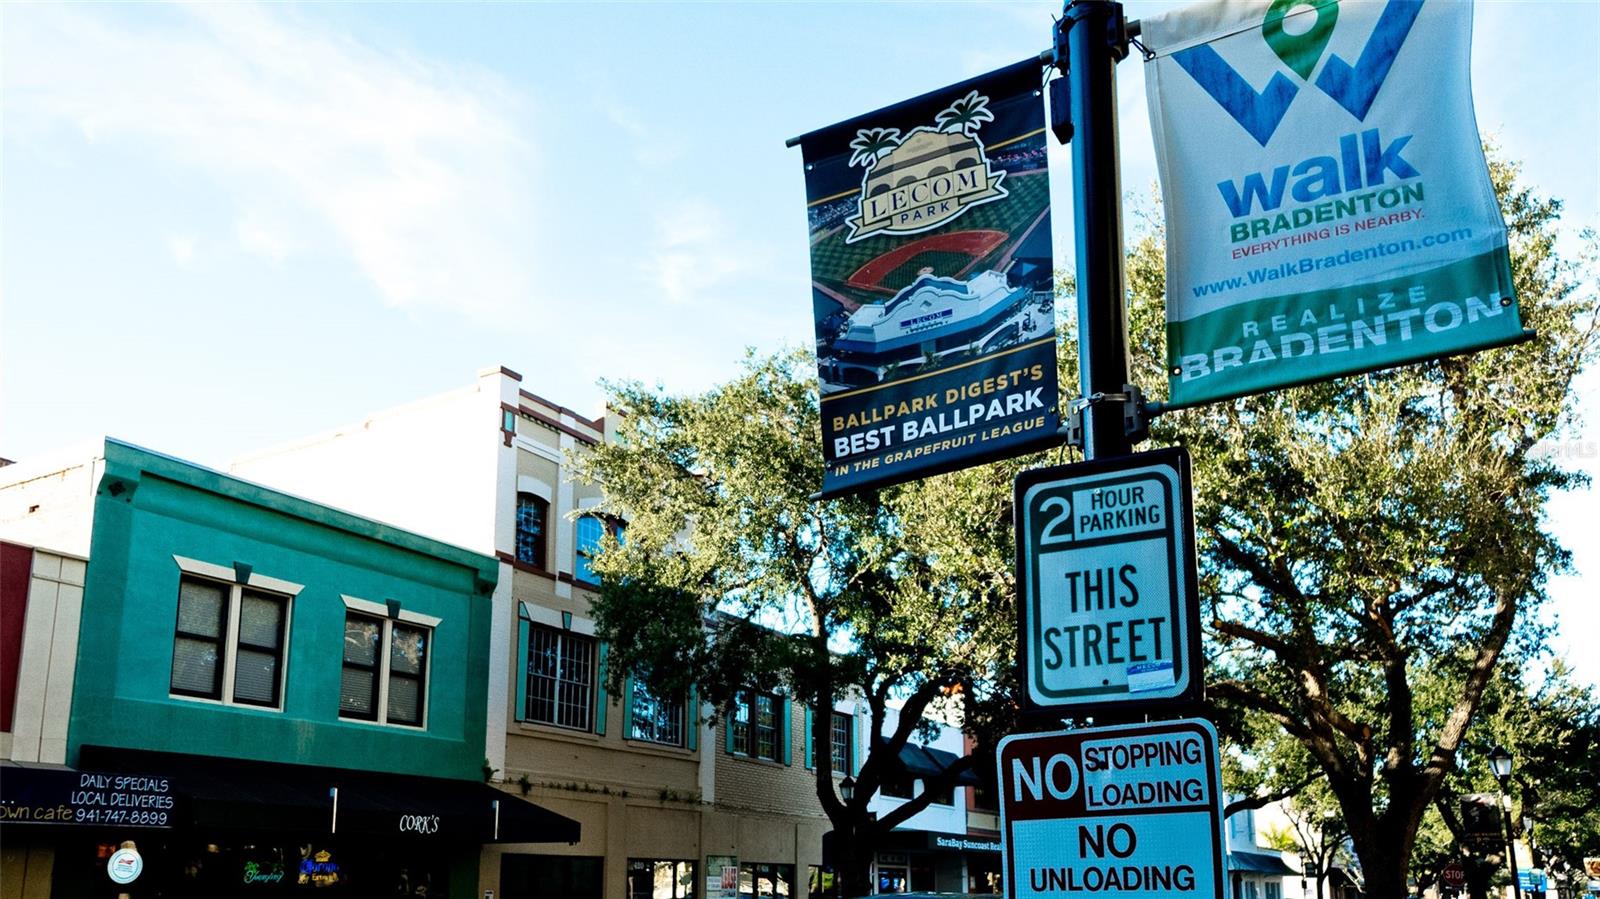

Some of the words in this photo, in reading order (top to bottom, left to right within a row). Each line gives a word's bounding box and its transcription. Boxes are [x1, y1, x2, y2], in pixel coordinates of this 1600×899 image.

[870, 168, 980, 219] LECOM
[1217, 128, 1420, 218] walk
[900, 201, 950, 224] PARK
[1230, 182, 1425, 243] BRADENTON
[1232, 227, 1331, 260] EVERYTHING
[1335, 222, 1350, 238] IS
[1354, 208, 1425, 231] NEARBY.
[1193, 226, 1472, 298] www.WalkBradenton.com
[1243, 286, 1427, 338] REALIZE
[1181, 292, 1503, 383] BRADENTON
[833, 394, 938, 432] BALLPARK
[946, 364, 1043, 404] DIGEST'S
[834, 425, 896, 458] BEST
[903, 387, 1044, 442] BALLPARK
[835, 465, 849, 477] IN
[854, 458, 879, 473] THE
[885, 434, 976, 464] GRAPEFRUIT
[982, 416, 1045, 441] LEAGUE
[1039, 496, 1073, 546] 2
[1080, 504, 1160, 533] PARKING
[1092, 486, 1144, 510] HOUR
[1065, 564, 1139, 613] THIS
[1043, 616, 1165, 670] STREET
[1012, 753, 1080, 802] NO
[1084, 738, 1201, 772] STOPPING
[71, 791, 107, 805] LOCAL
[110, 792, 174, 809] DELIVERIES
[80, 774, 113, 788] DAILY
[114, 776, 169, 792] SPECIALS
[1088, 778, 1203, 807] LOADING
[33, 804, 73, 820] cafe
[75, 808, 167, 825] 941-747-8899
[936, 837, 962, 850] SaraBay
[1078, 823, 1137, 858] NO
[1030, 865, 1195, 892] UNLOADING
